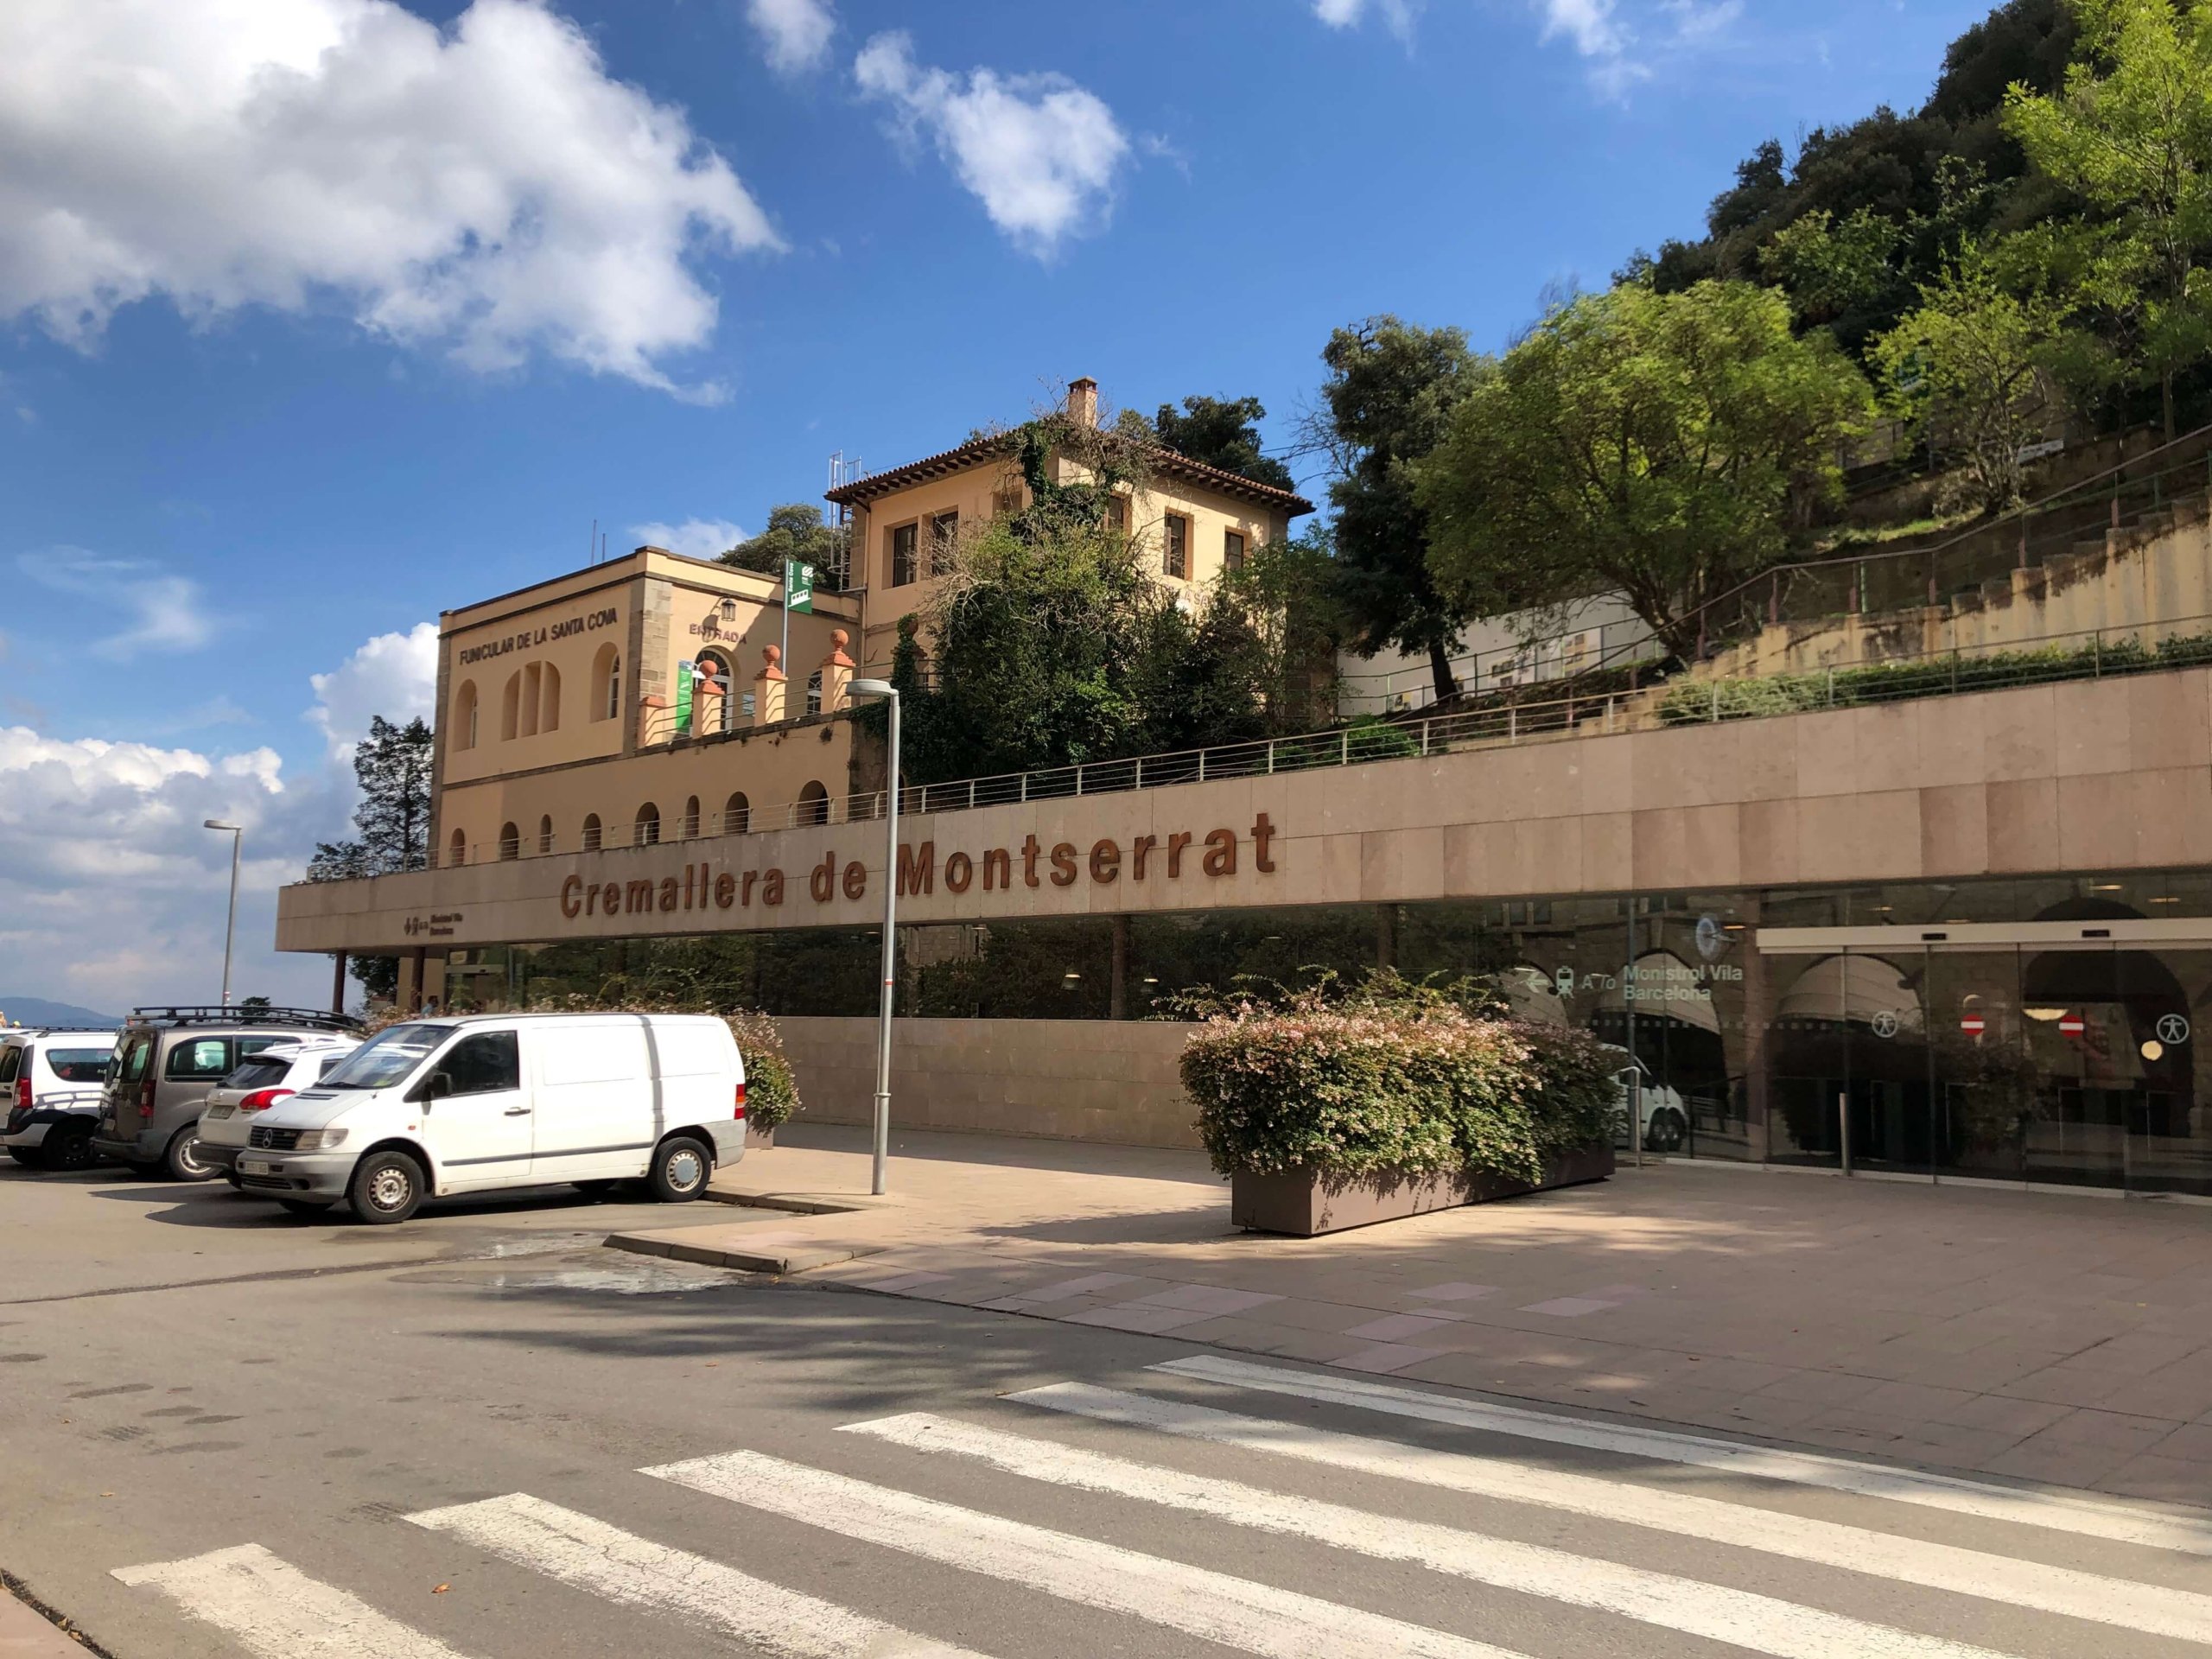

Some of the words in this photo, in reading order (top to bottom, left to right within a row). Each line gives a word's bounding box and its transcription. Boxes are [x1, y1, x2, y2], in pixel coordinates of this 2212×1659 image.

[459, 637, 514, 665] FUNICULAR
[517, 632, 531, 651] DE
[534, 627, 547, 645] LA
[550, 617, 585, 640] SANTA
[588, 607, 618, 631] COVA
[689, 623, 747, 645] ENTRADA
[561, 862, 785, 918] Cremallera
[810, 851, 867, 902] de
[895, 812, 1276, 896] Montserrat
[1581, 975, 1593, 989] A
[1623, 964, 1705, 981] Monistrol
[1709, 964, 1743, 981] Vila
[1624, 984, 1712, 1001] Barcelona
